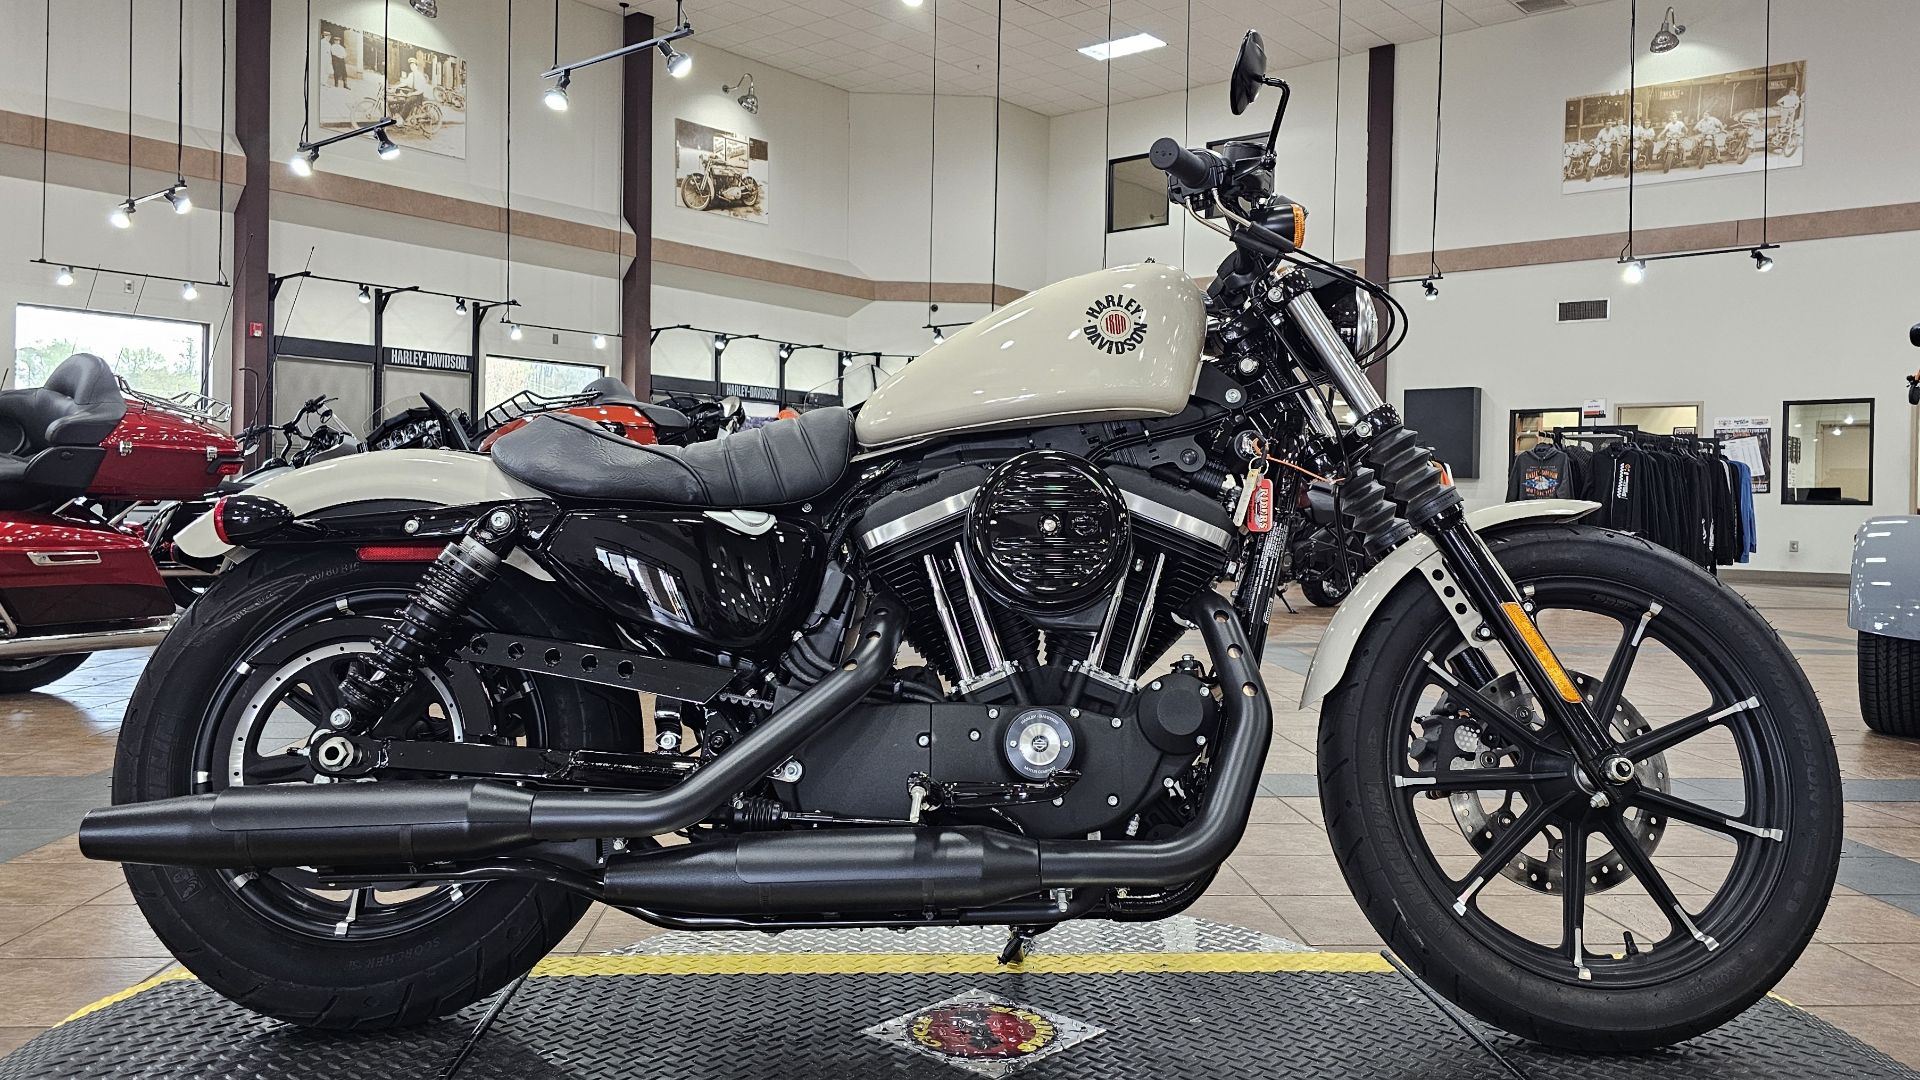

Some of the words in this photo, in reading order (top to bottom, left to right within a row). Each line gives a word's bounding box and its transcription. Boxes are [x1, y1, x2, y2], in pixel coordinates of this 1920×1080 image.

[1085, 294, 1144, 320] HARLEY
[1105, 313, 1127, 335] IRON
[1083, 321, 1148, 355] DAVIDSON
[391, 348, 468, 371] HARLEY-DAVIDSON
[726, 383, 778, 400] HARLEY-DAVIDSON
[1259, 488, 1269, 529] RIDERS
